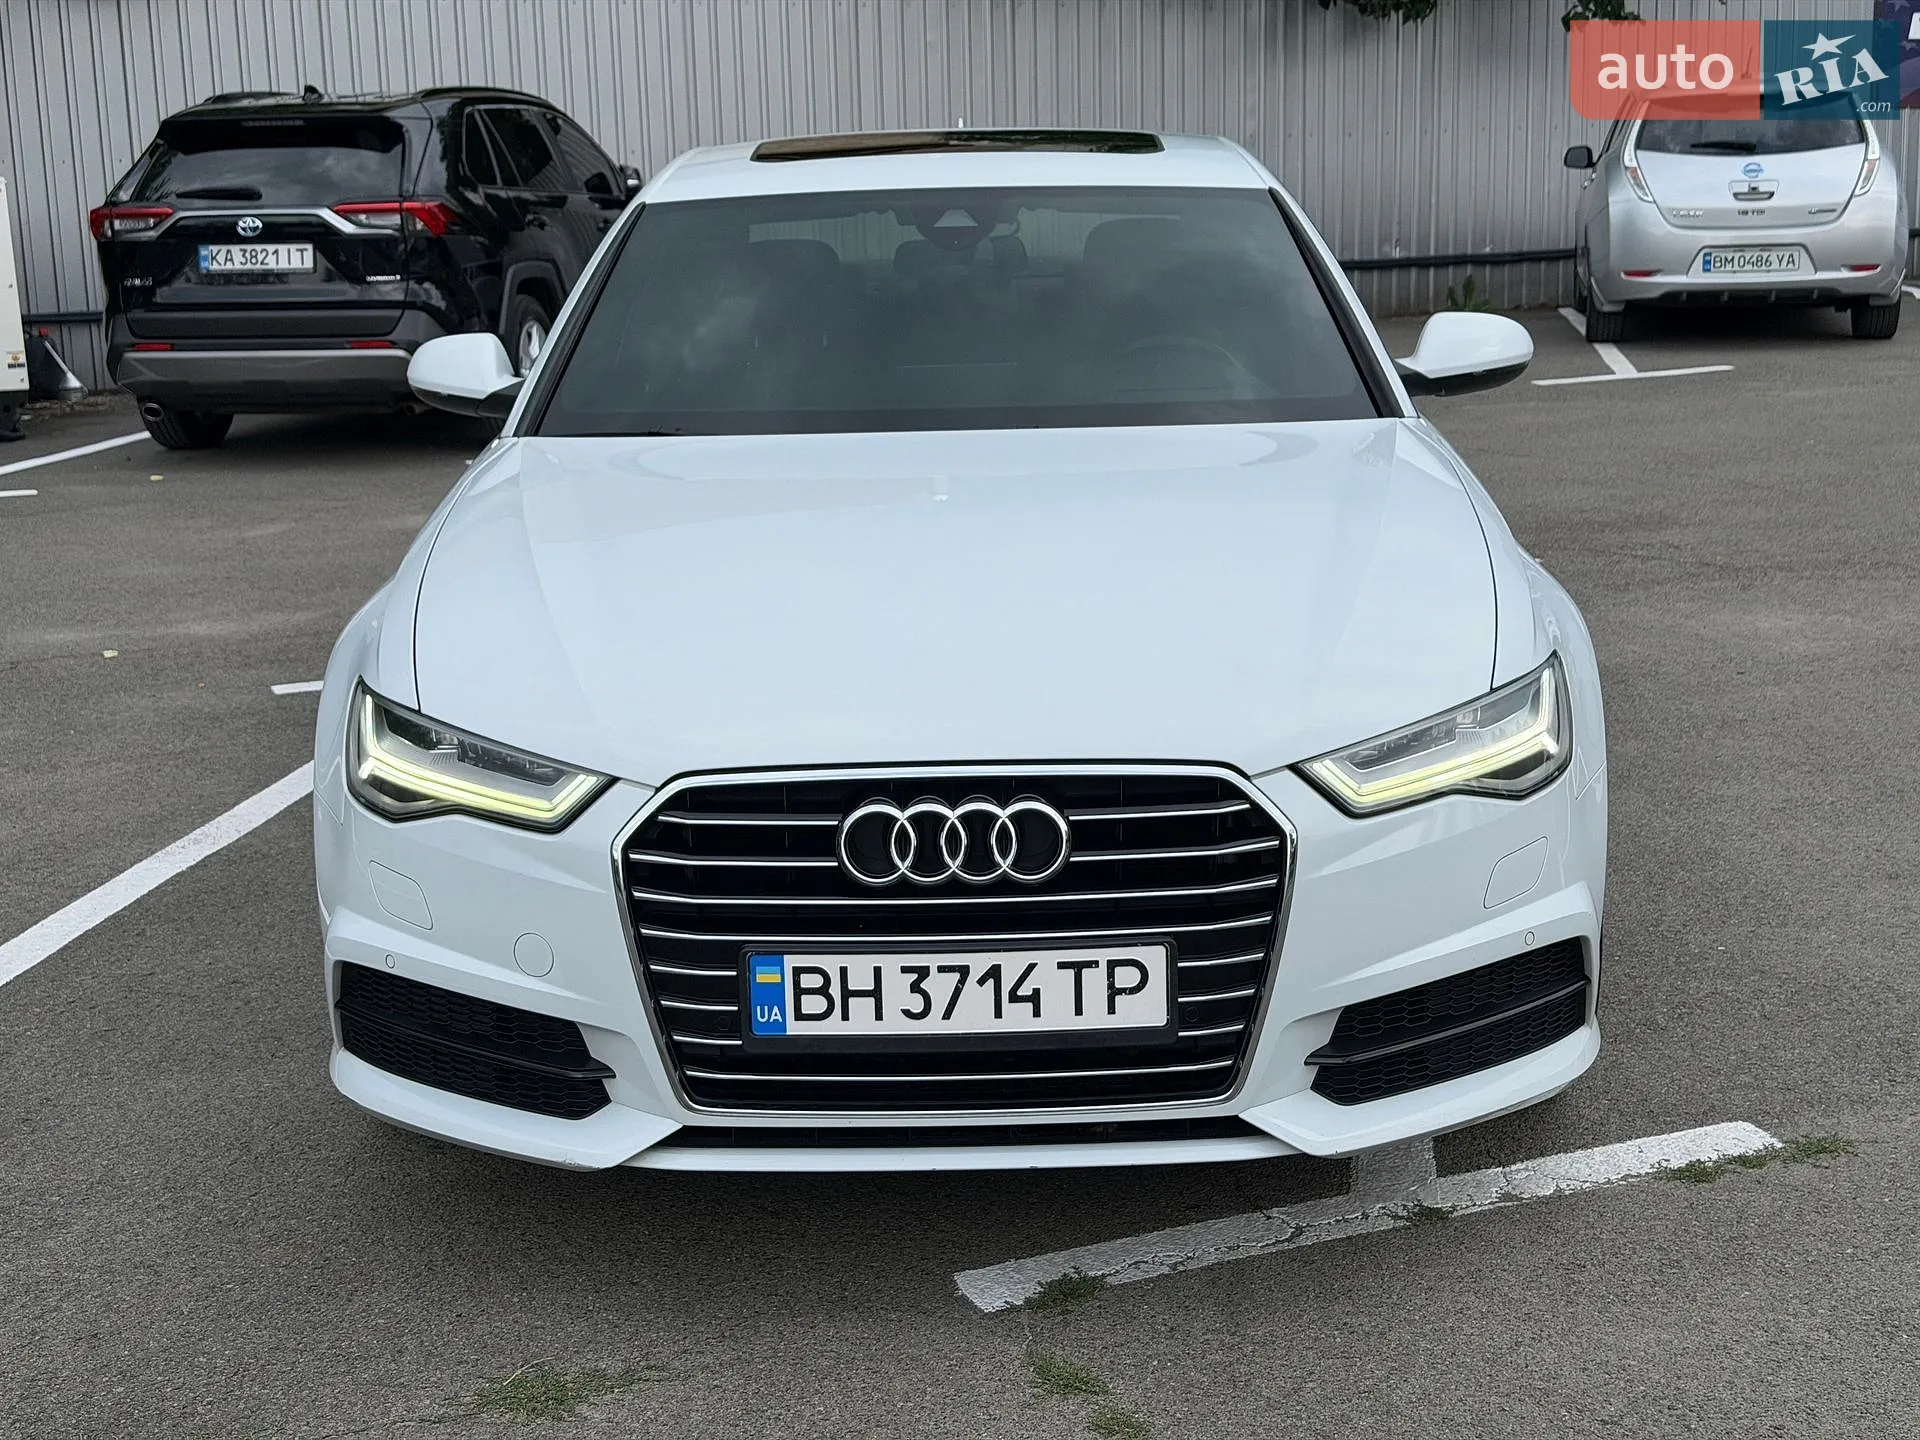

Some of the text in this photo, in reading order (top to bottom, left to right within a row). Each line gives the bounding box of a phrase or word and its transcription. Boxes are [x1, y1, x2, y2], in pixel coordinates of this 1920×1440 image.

[210, 248, 309, 266] KA 3821 IT
[1712, 255, 1735, 269] BM
[1737, 254, 1773, 269] 0486
[1776, 252, 1796, 268] YA
[790, 958, 1151, 1022] BH 3714 TP
[755, 1005, 783, 1024] UA
